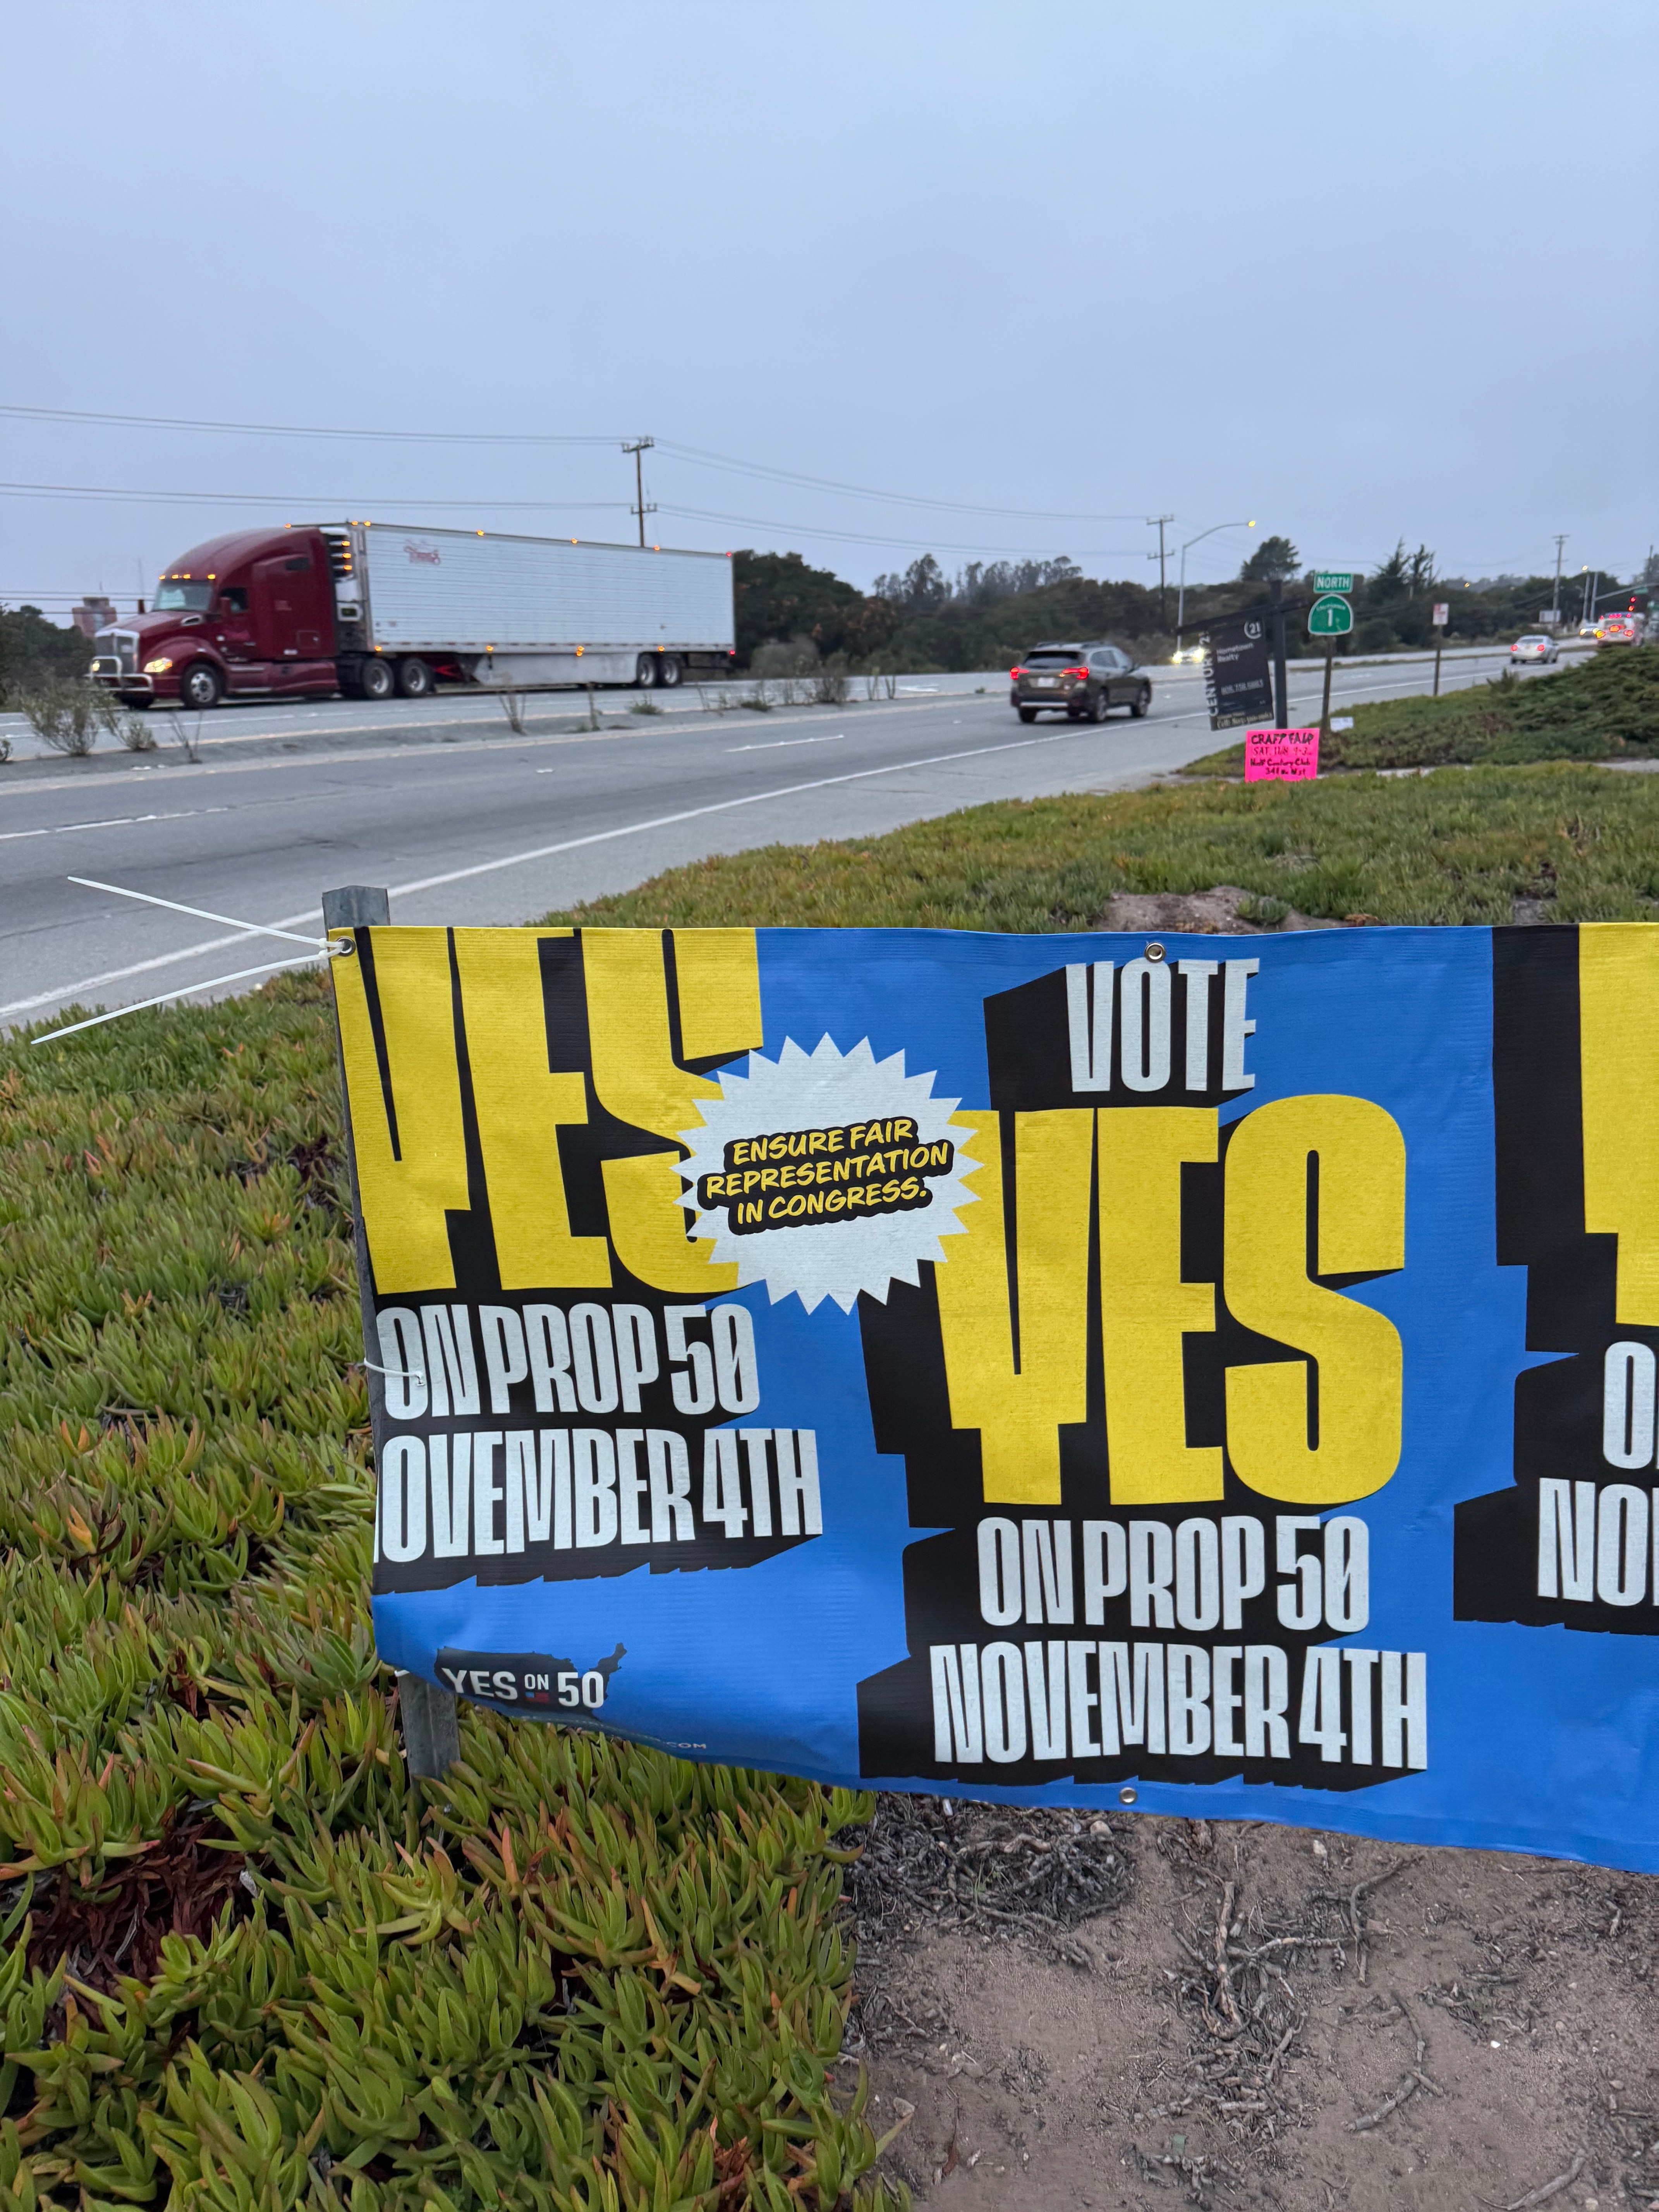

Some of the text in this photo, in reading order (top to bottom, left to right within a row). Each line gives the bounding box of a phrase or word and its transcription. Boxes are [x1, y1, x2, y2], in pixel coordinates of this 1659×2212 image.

[1317, 576, 1350, 589] NORTH
[1328, 609, 1333, 627] 1
[1251, 732, 1314, 745] CRAFT FAIR
[1066, 957, 1259, 1092] VOTE
[329, 927, 763, 1294] YES
[733, 1119, 913, 1165] ENSURE FAIR
[706, 1143, 949, 1199] REPRESENTATION
[737, 1177, 927, 1224] IN CONGRESS.
[934, 1094, 1407, 1505] YES
[376, 1303, 760, 1420] ON PROP 50
[1603, 1341, 1659, 1470] O
[373, 1428, 823, 1563] OVEMBER 4TH
[1538, 1477, 1659, 1607] NO
[977, 1515, 1369, 1632] ON PROP 50
[441, 1667, 604, 1708] YES ON 50
[929, 1640, 1427, 1770] NOVEMBER 4TH
